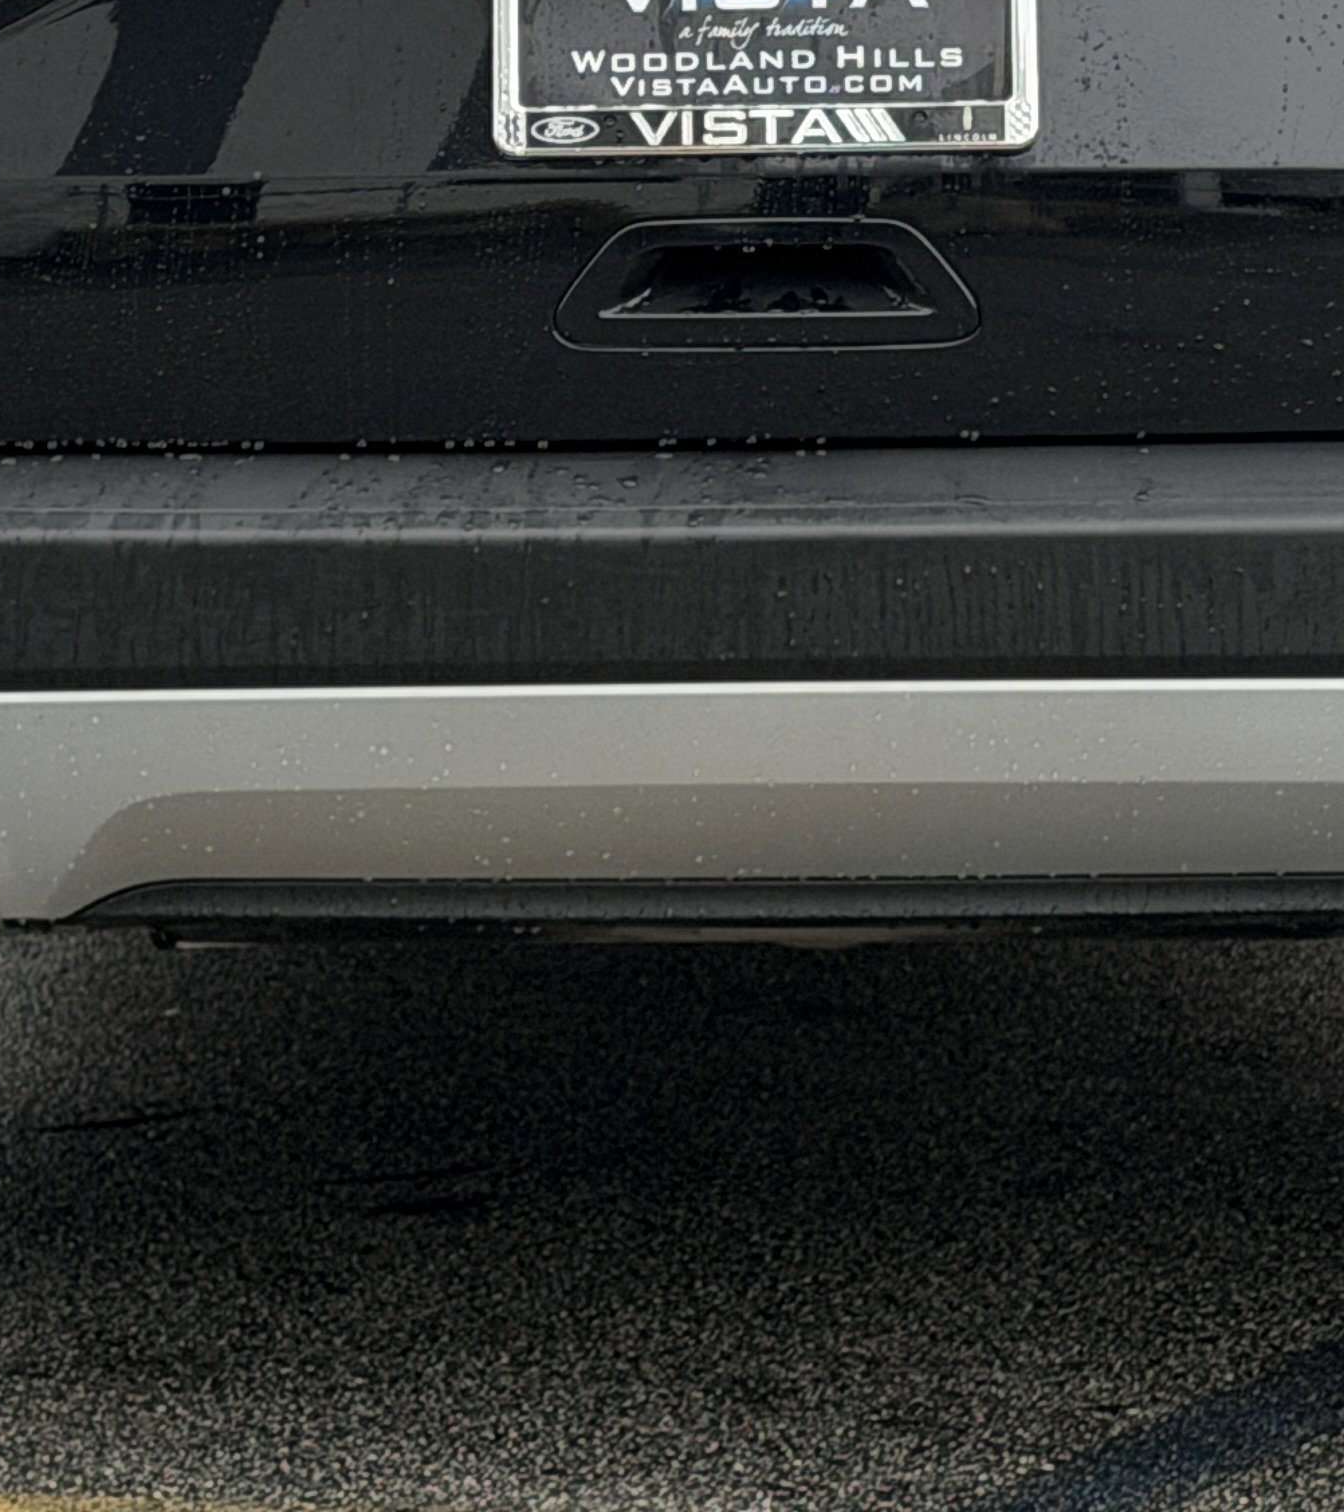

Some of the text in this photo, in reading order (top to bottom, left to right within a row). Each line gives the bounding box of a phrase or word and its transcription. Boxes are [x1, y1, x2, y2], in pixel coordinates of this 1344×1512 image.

[678, 14, 849, 50] a family tradition
[571, 45, 964, 74] WOODLAND HILLS
[630, 108, 844, 146] VISTA
